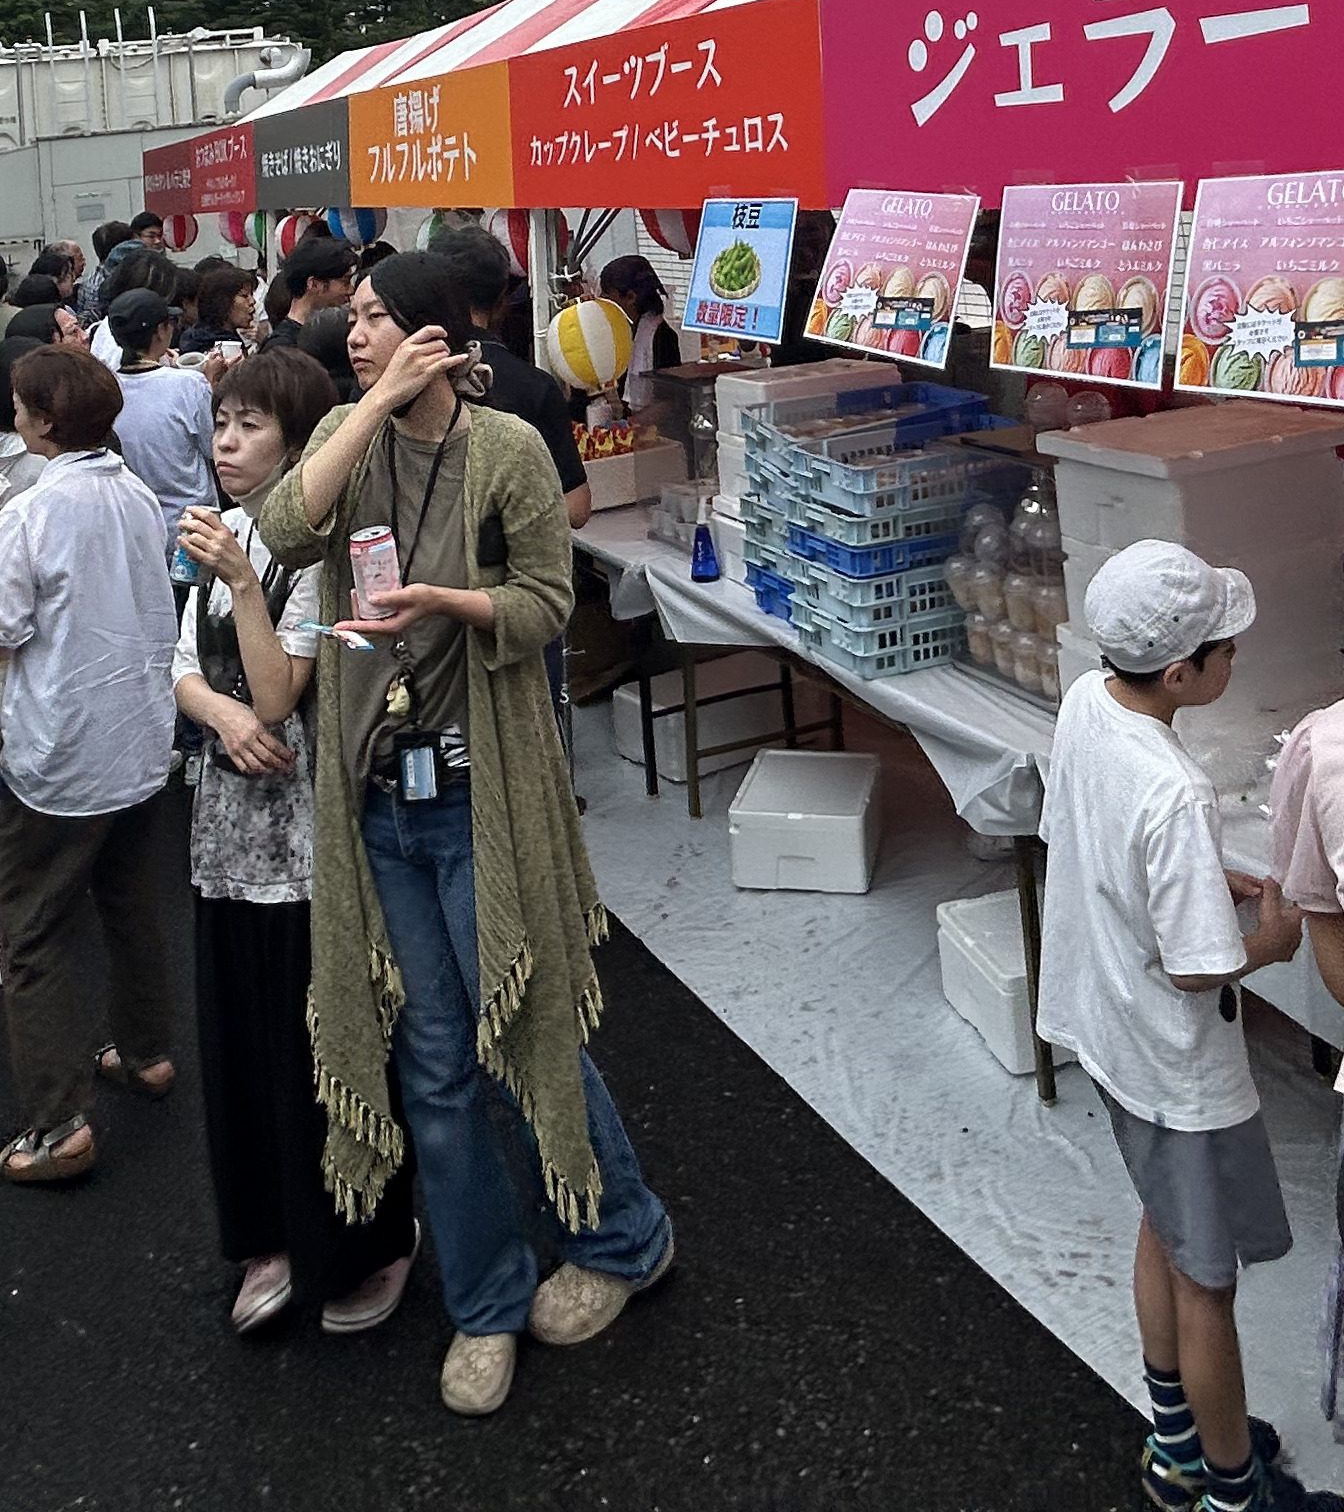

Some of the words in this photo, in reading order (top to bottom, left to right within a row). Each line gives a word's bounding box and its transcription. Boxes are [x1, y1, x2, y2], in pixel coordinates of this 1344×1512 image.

[562, 38, 722, 109] スイーツブース
[392, 83, 442, 138] 唐揚げ
[367, 131, 478, 183] フルフルポテト
[732, 202, 764, 230] 枝豆
[881, 196, 934, 217] GELATO
[1051, 190, 1121, 212] GELATO
[695, 299, 759, 330] 数量限定！
